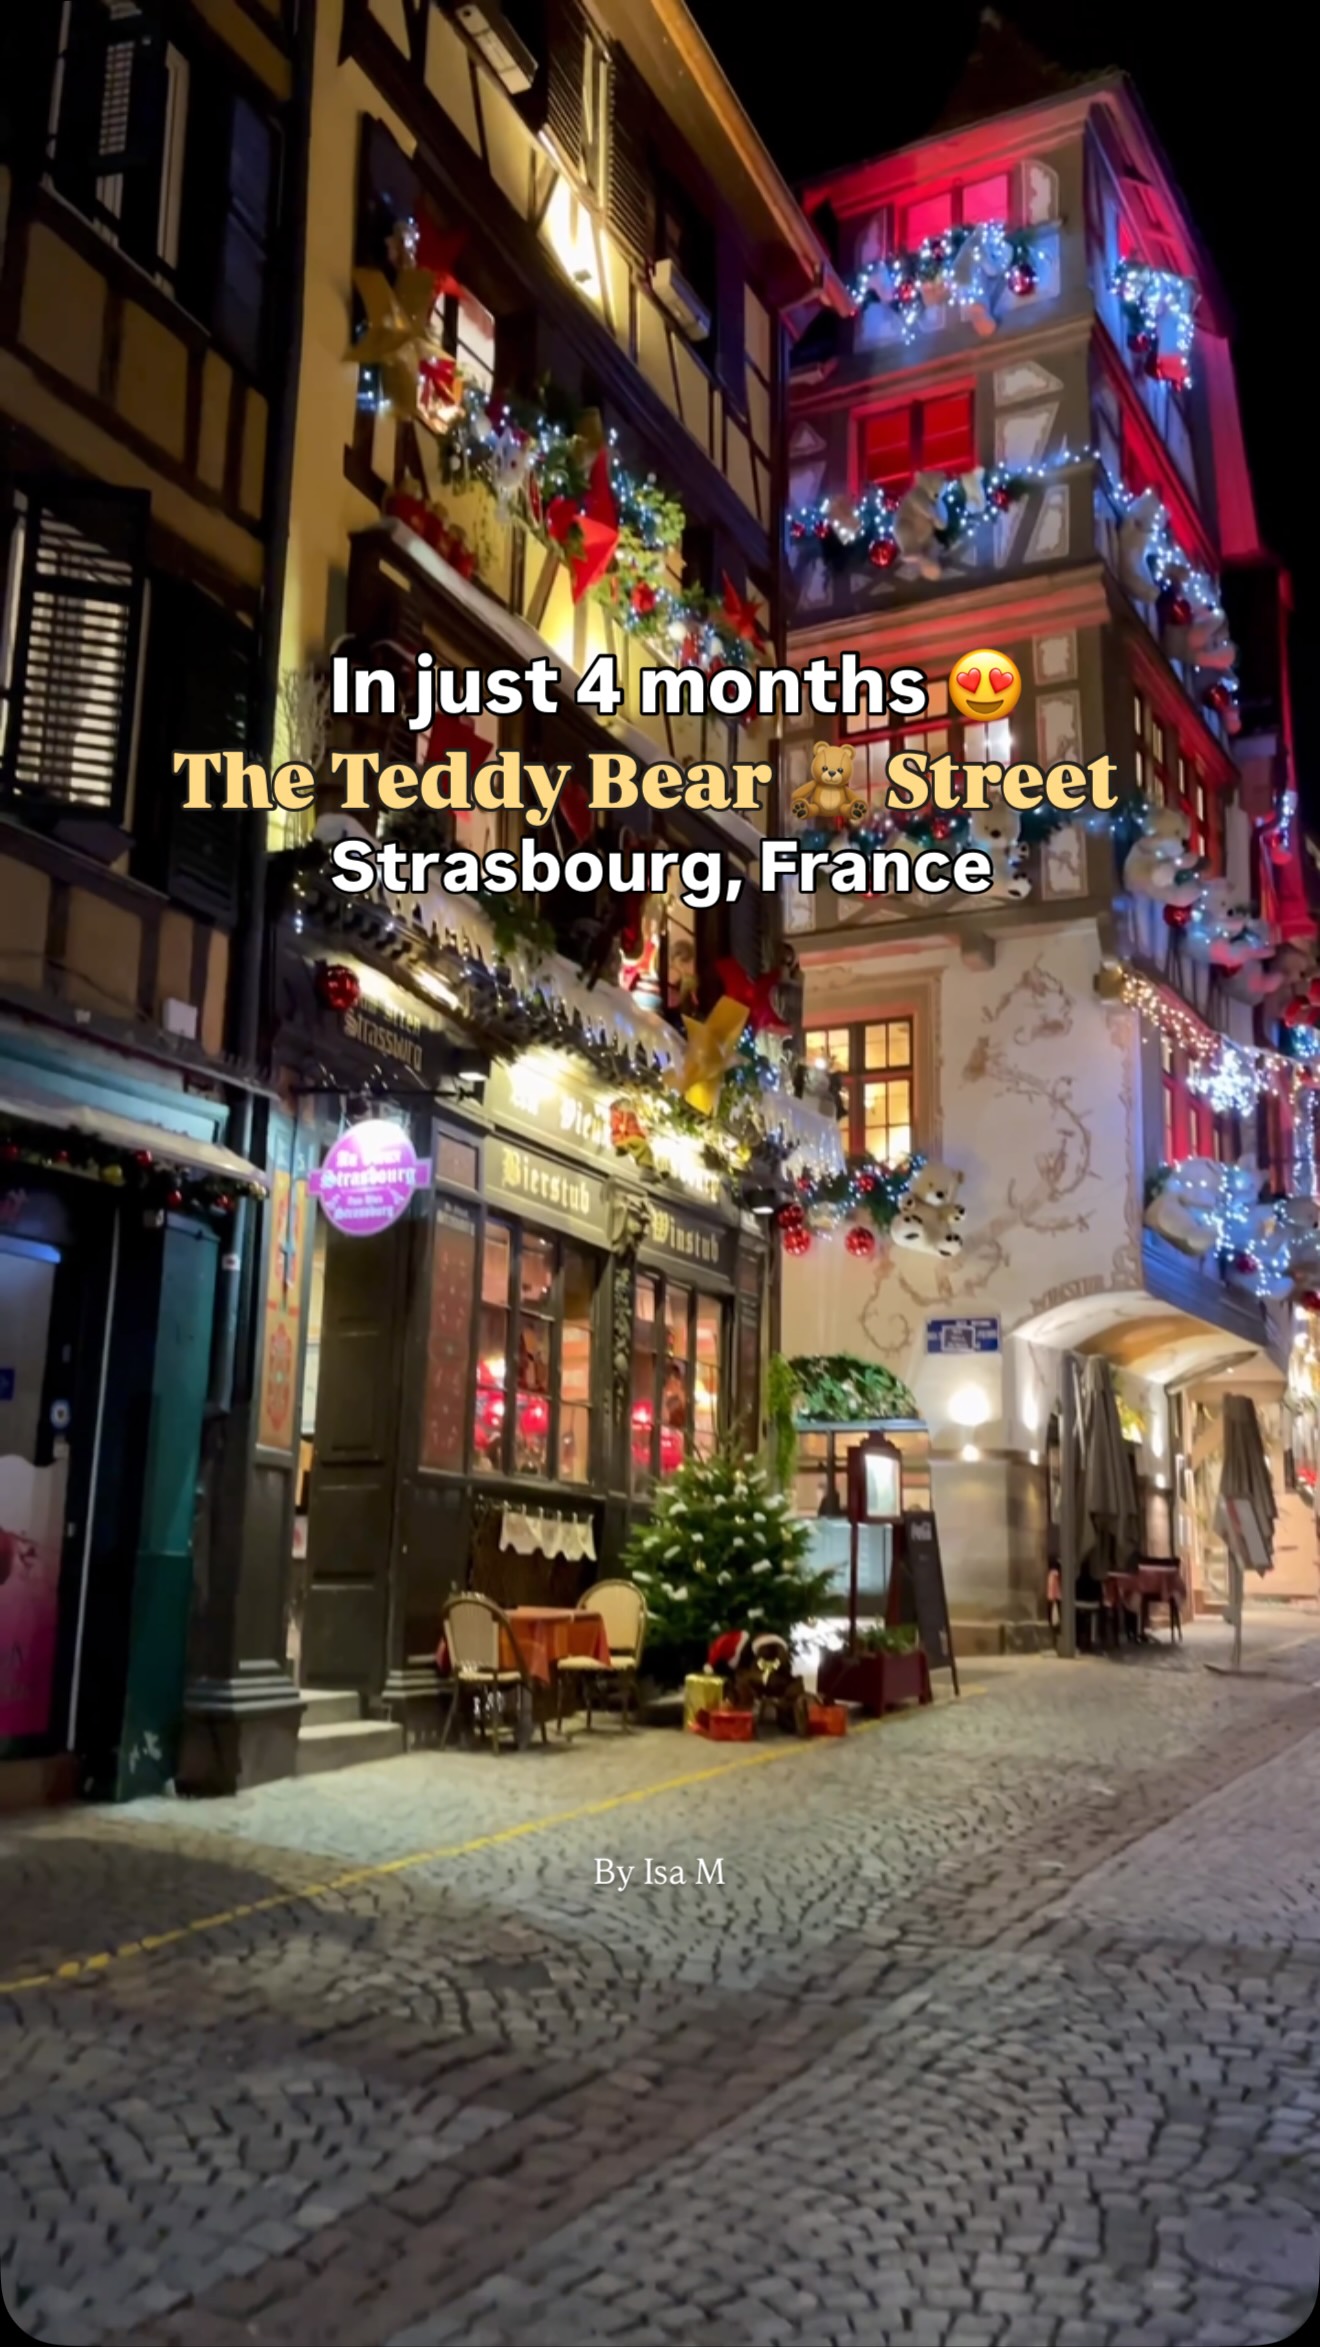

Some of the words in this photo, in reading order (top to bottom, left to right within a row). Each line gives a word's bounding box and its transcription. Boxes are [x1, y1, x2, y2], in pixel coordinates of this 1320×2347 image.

[320, 1166, 416, 1189] Strasbourg
[500, 1147, 591, 1215] Bierstub
[650, 1208, 720, 1265] Winstub
